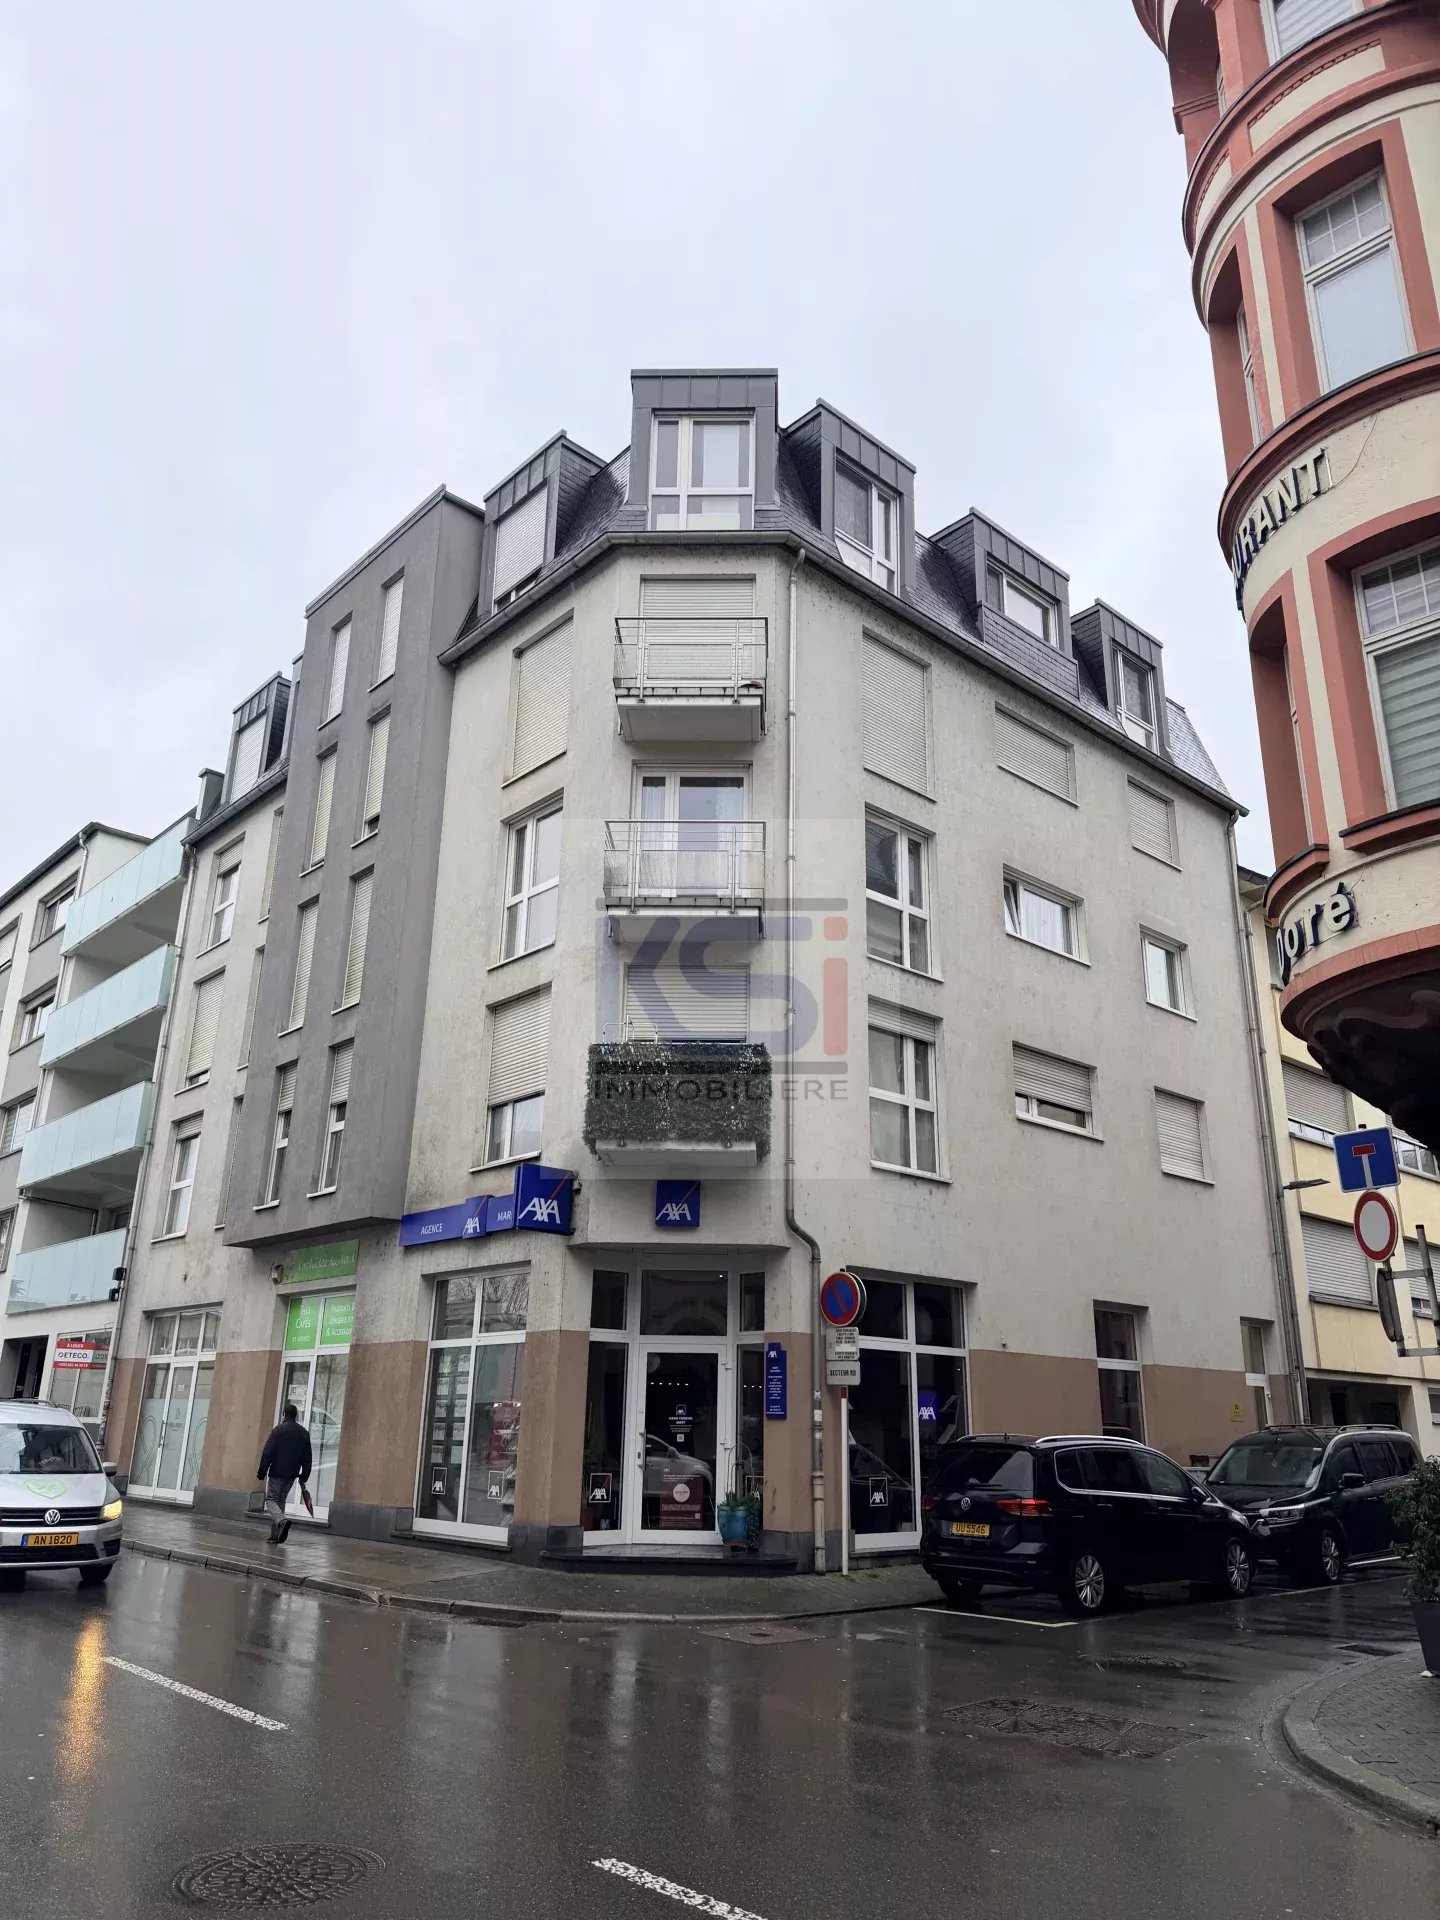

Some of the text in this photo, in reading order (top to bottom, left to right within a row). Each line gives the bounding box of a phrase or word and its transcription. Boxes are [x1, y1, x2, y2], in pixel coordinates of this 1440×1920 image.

[1231, 447, 1333, 590] URANT
[518, 1197, 561, 1224] AXA
[655, 1202, 692, 1221] AXA
[420, 1210, 512, 1235] AGENCE AXA MAR
[830, 1369, 850, 1377] SECTEUR
[918, 1406, 936, 1420] AXA
[590, 1488, 607, 1500] AXA
[33, 1534, 73, 1545] AN 1820
